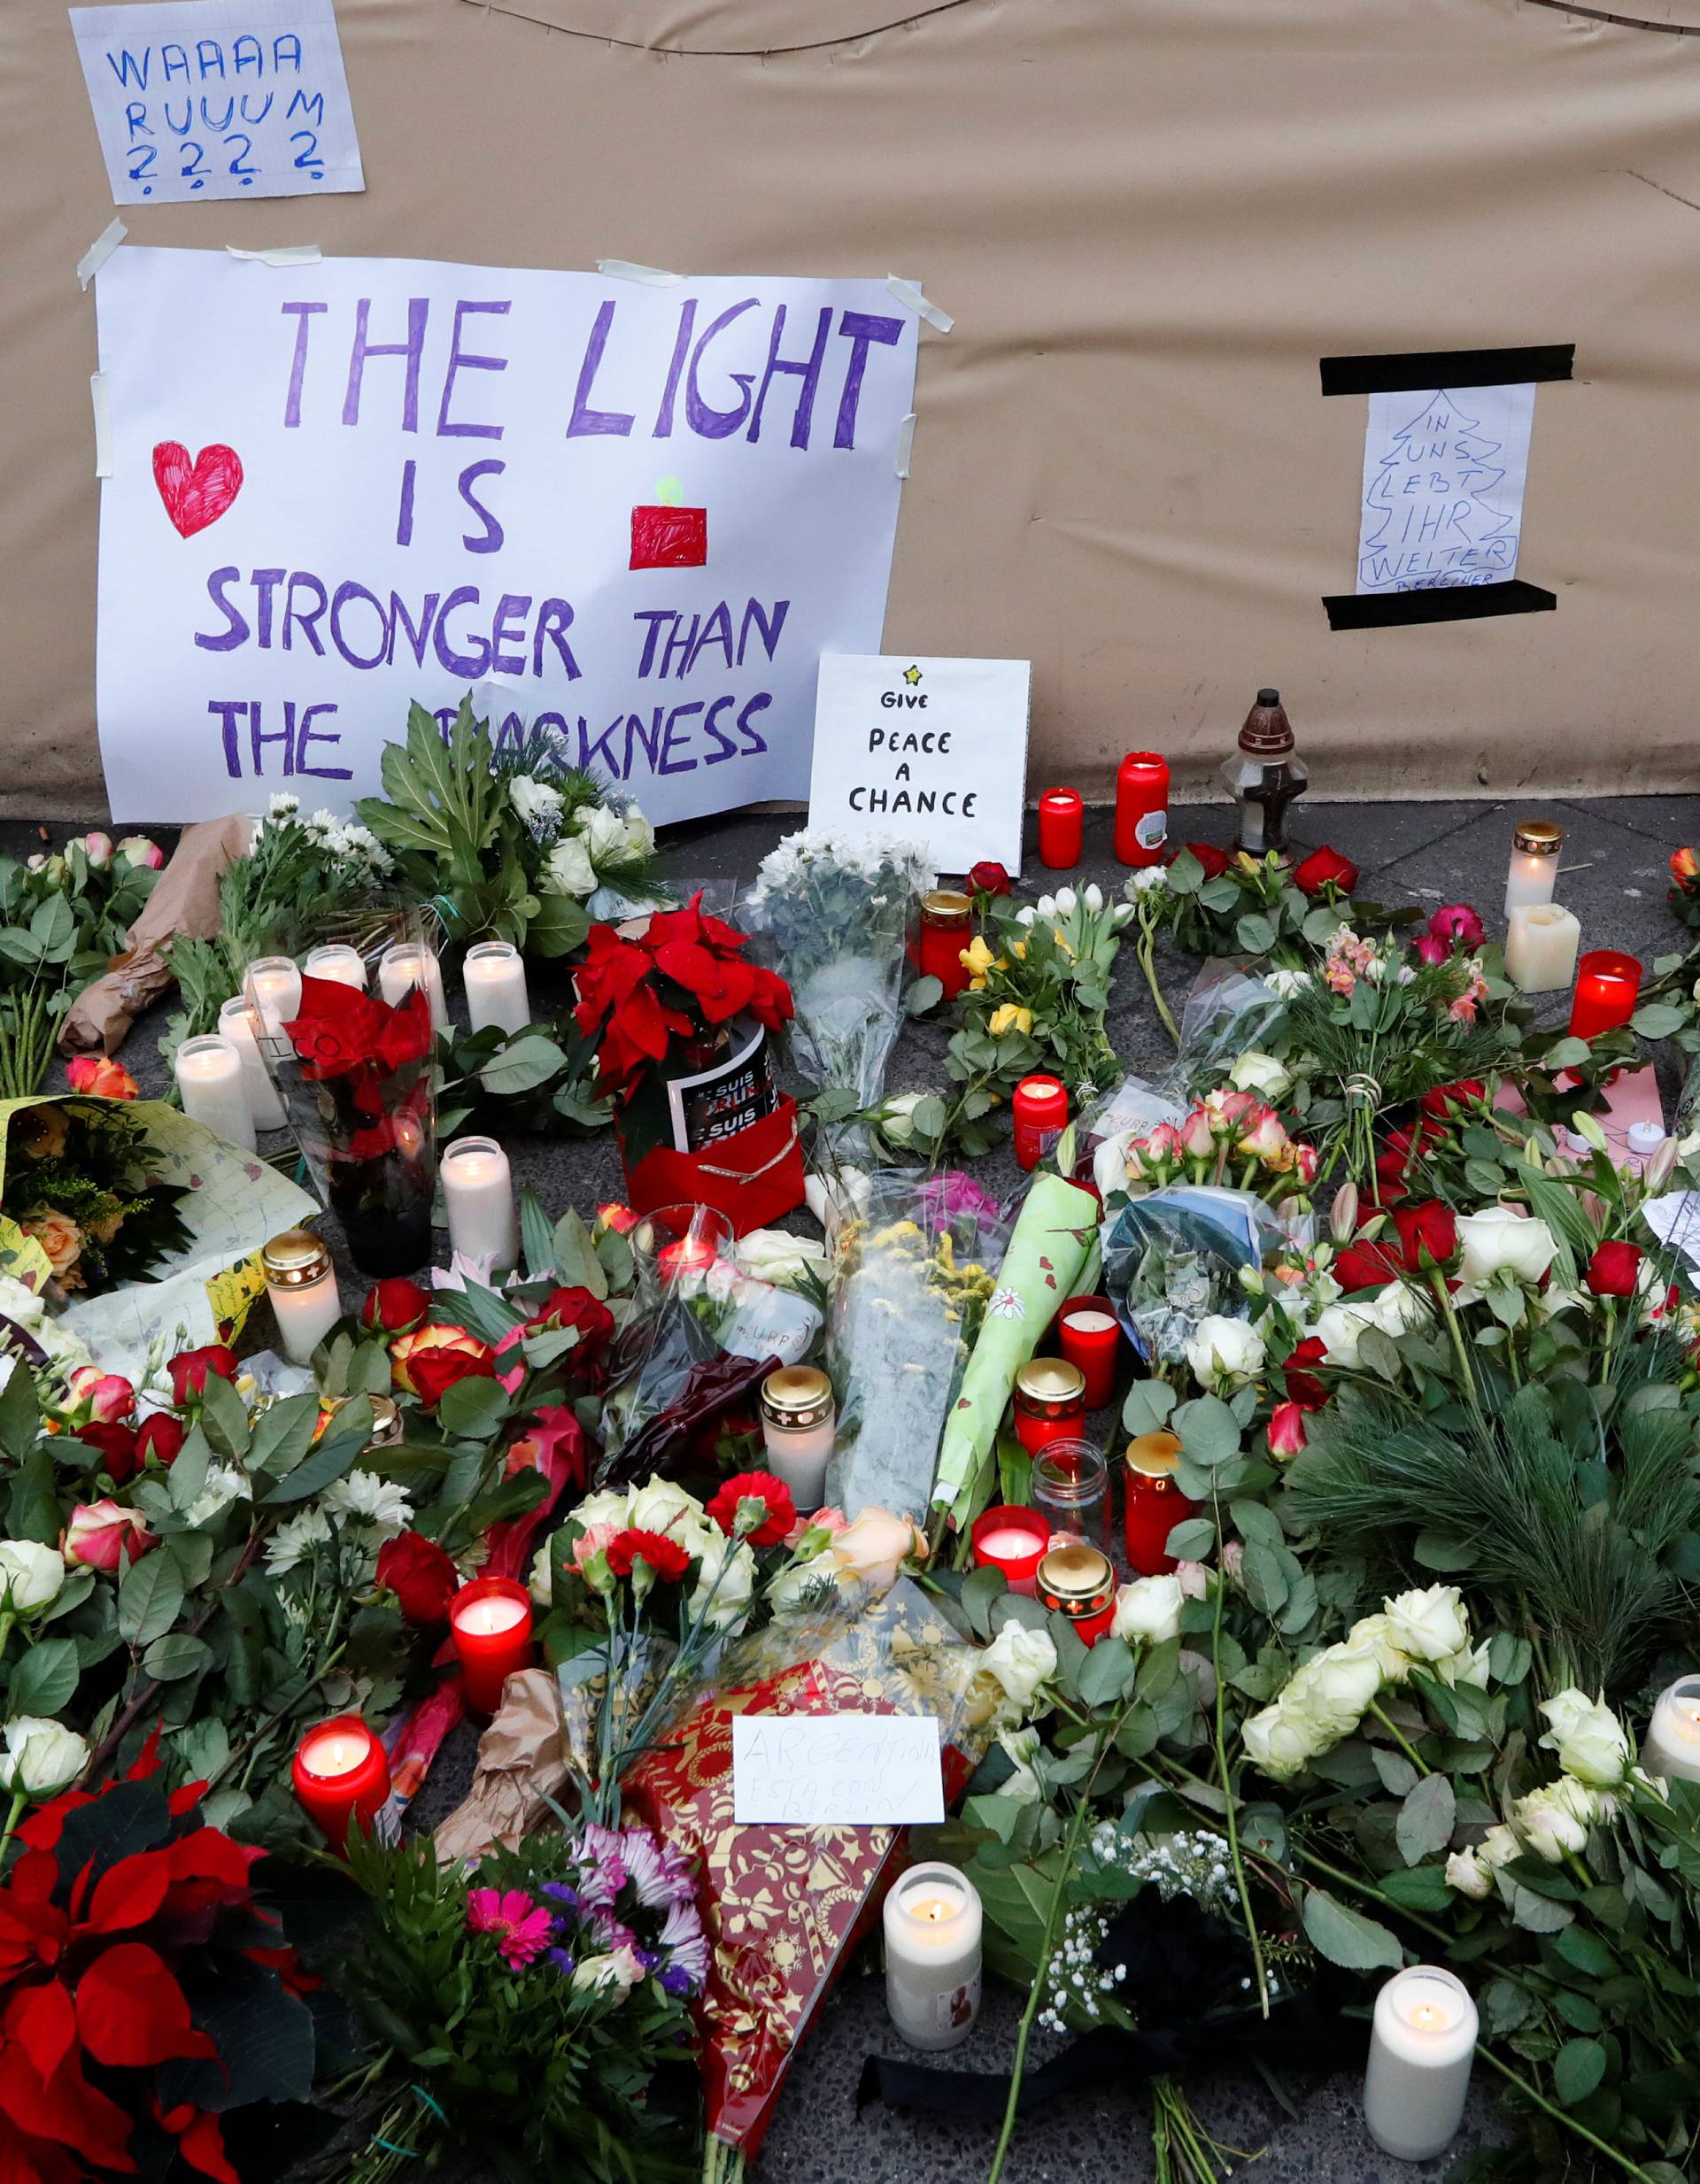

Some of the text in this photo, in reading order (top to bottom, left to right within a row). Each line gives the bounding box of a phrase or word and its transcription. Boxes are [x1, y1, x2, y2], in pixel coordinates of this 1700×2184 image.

[106, 34, 301, 91] WAAAA
[125, 89, 325, 143] RUUUM
[281, 297, 906, 451] THE LIGHT
[1426, 413, 1449, 432] IN
[1407, 441, 1472, 462] UNS
[1380, 470, 1483, 498] LEBT
[397, 459, 506, 553] IS
[1402, 500, 1472, 544] IHR
[1372, 540, 1507, 580] WEITER
[195, 566, 791, 681] STRONGER THAN
[880, 691, 928, 709] GIVE
[207, 700, 353, 780] THE
[869, 728, 952, 753] PEACE
[895, 762, 910, 782] A
[849, 787, 978, 818] CHANCE
[715, 1070, 754, 1097] SUIS
[709, 1107, 757, 1138] SUIS
